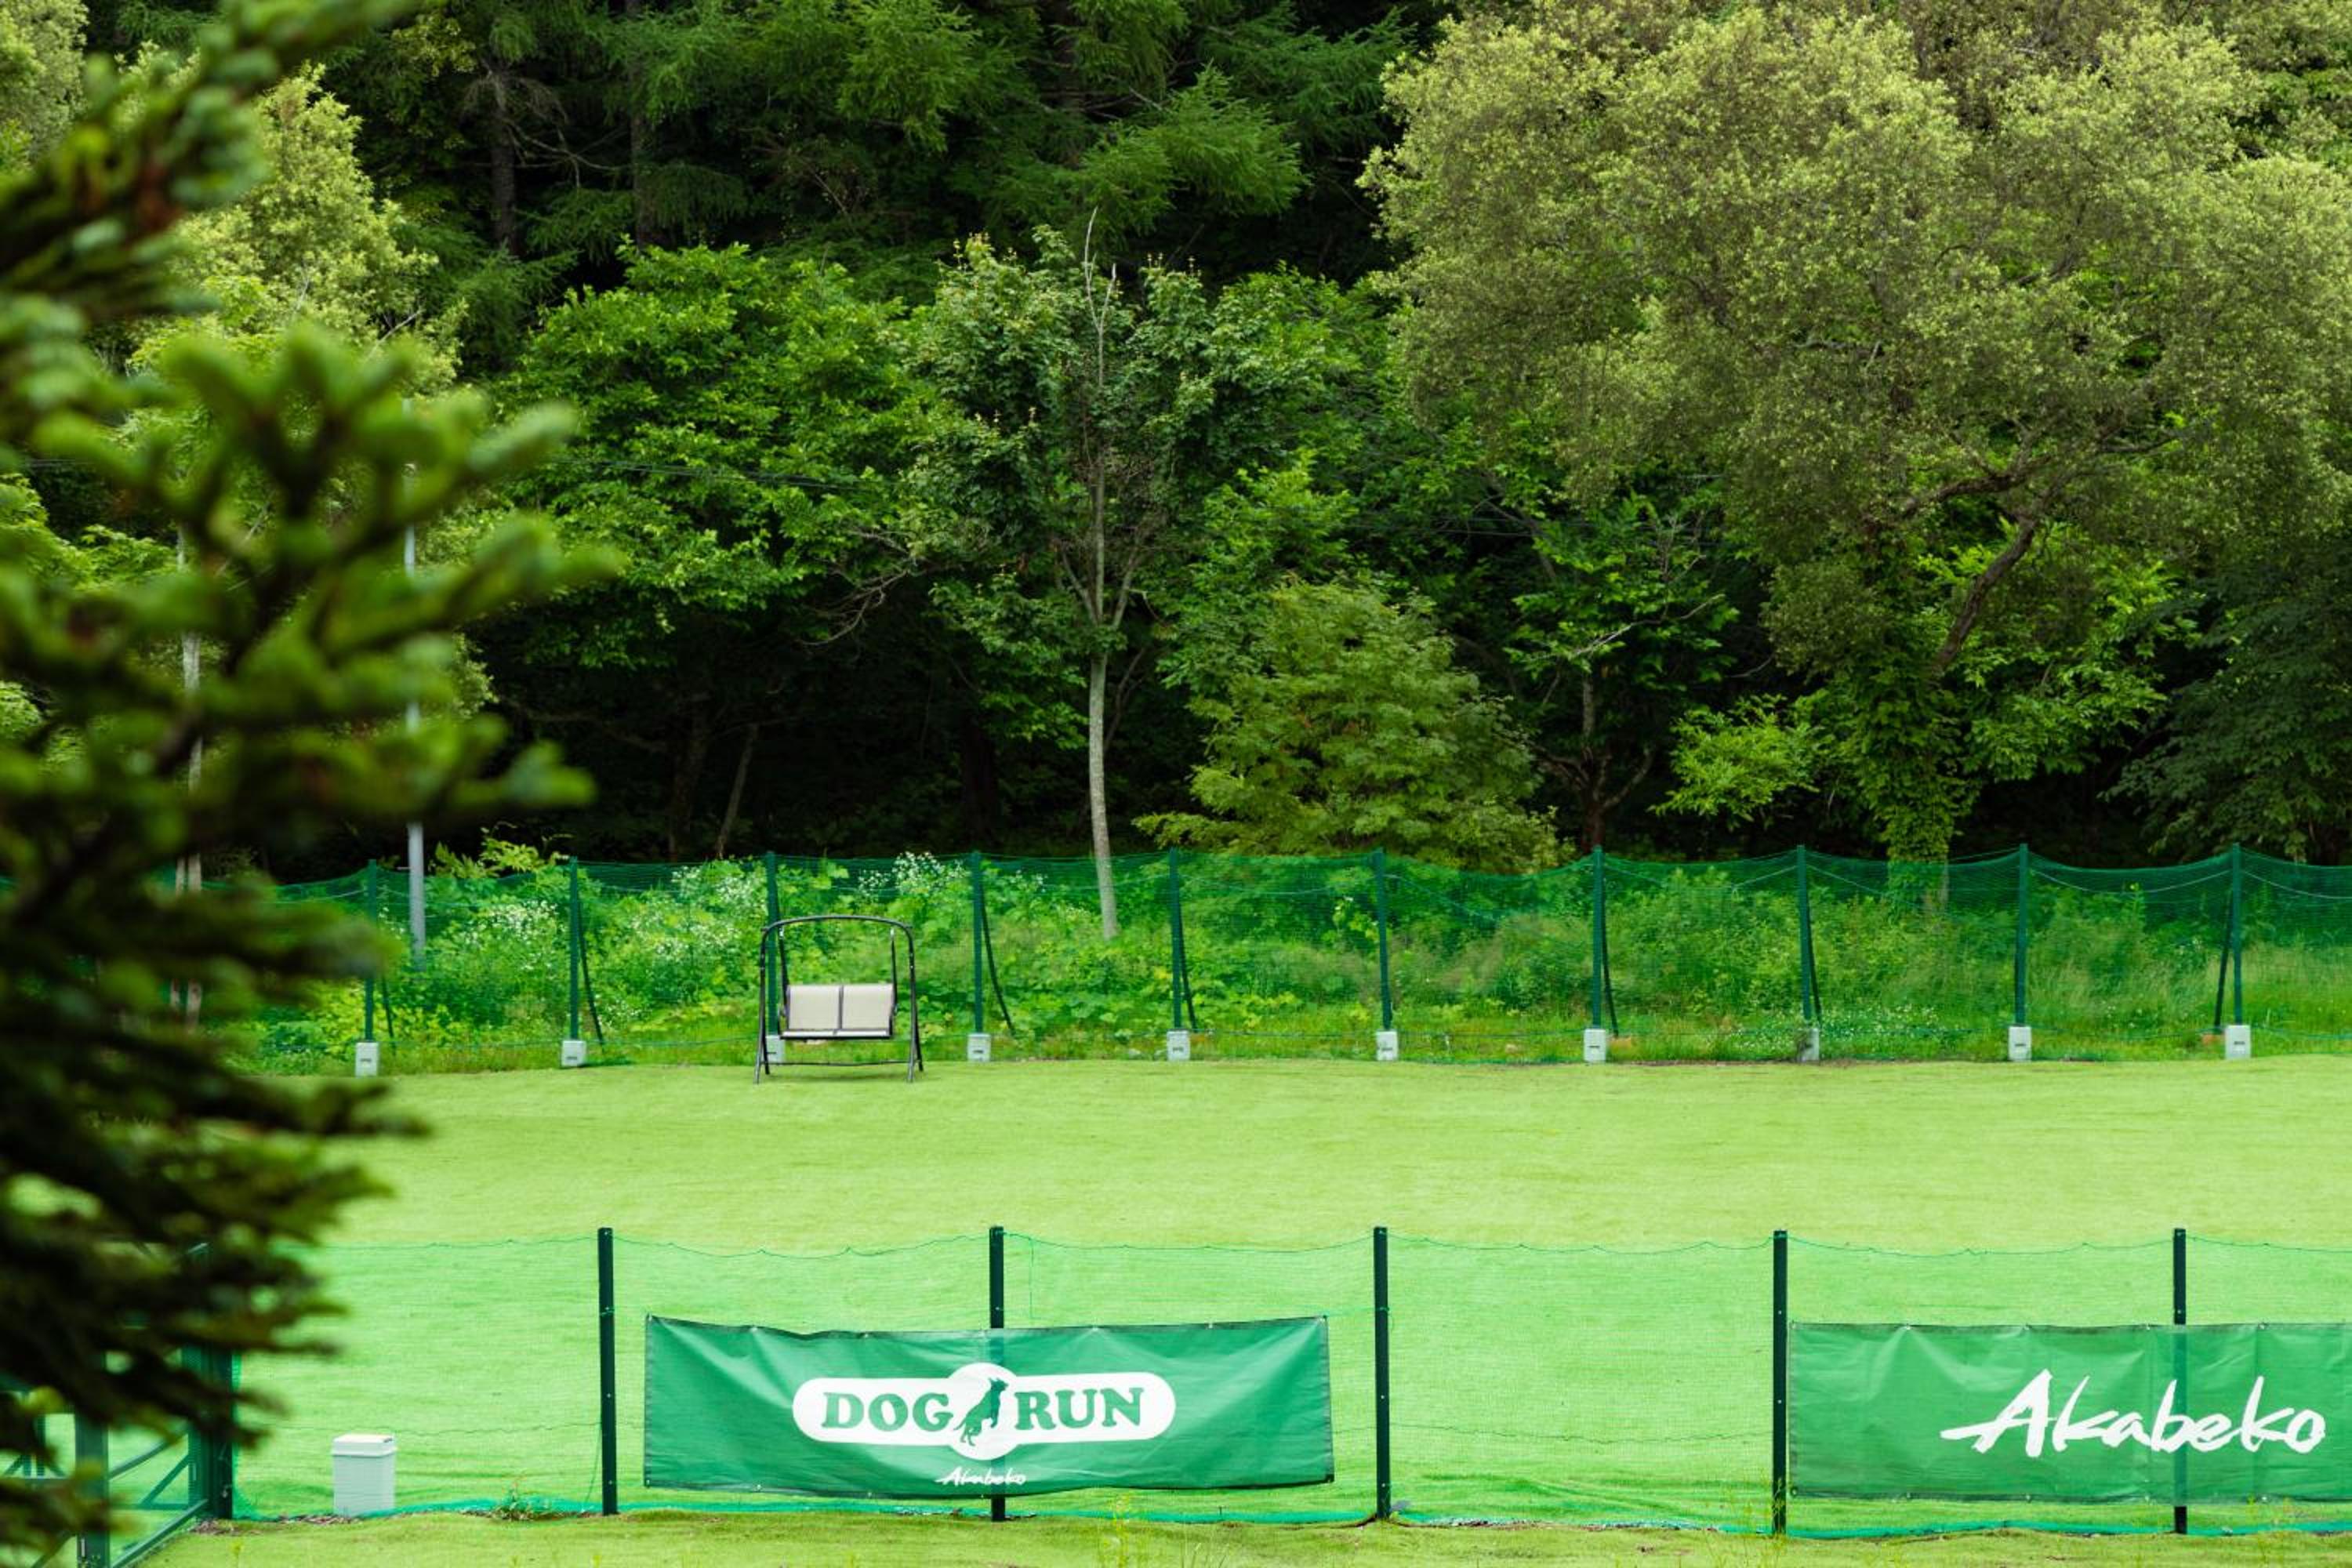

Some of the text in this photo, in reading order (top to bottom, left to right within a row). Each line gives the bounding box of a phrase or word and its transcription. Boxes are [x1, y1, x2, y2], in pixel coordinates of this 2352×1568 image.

[822, 1387, 1144, 1432] DOG RUN
[1940, 1369, 2326, 1457] Akabeko
